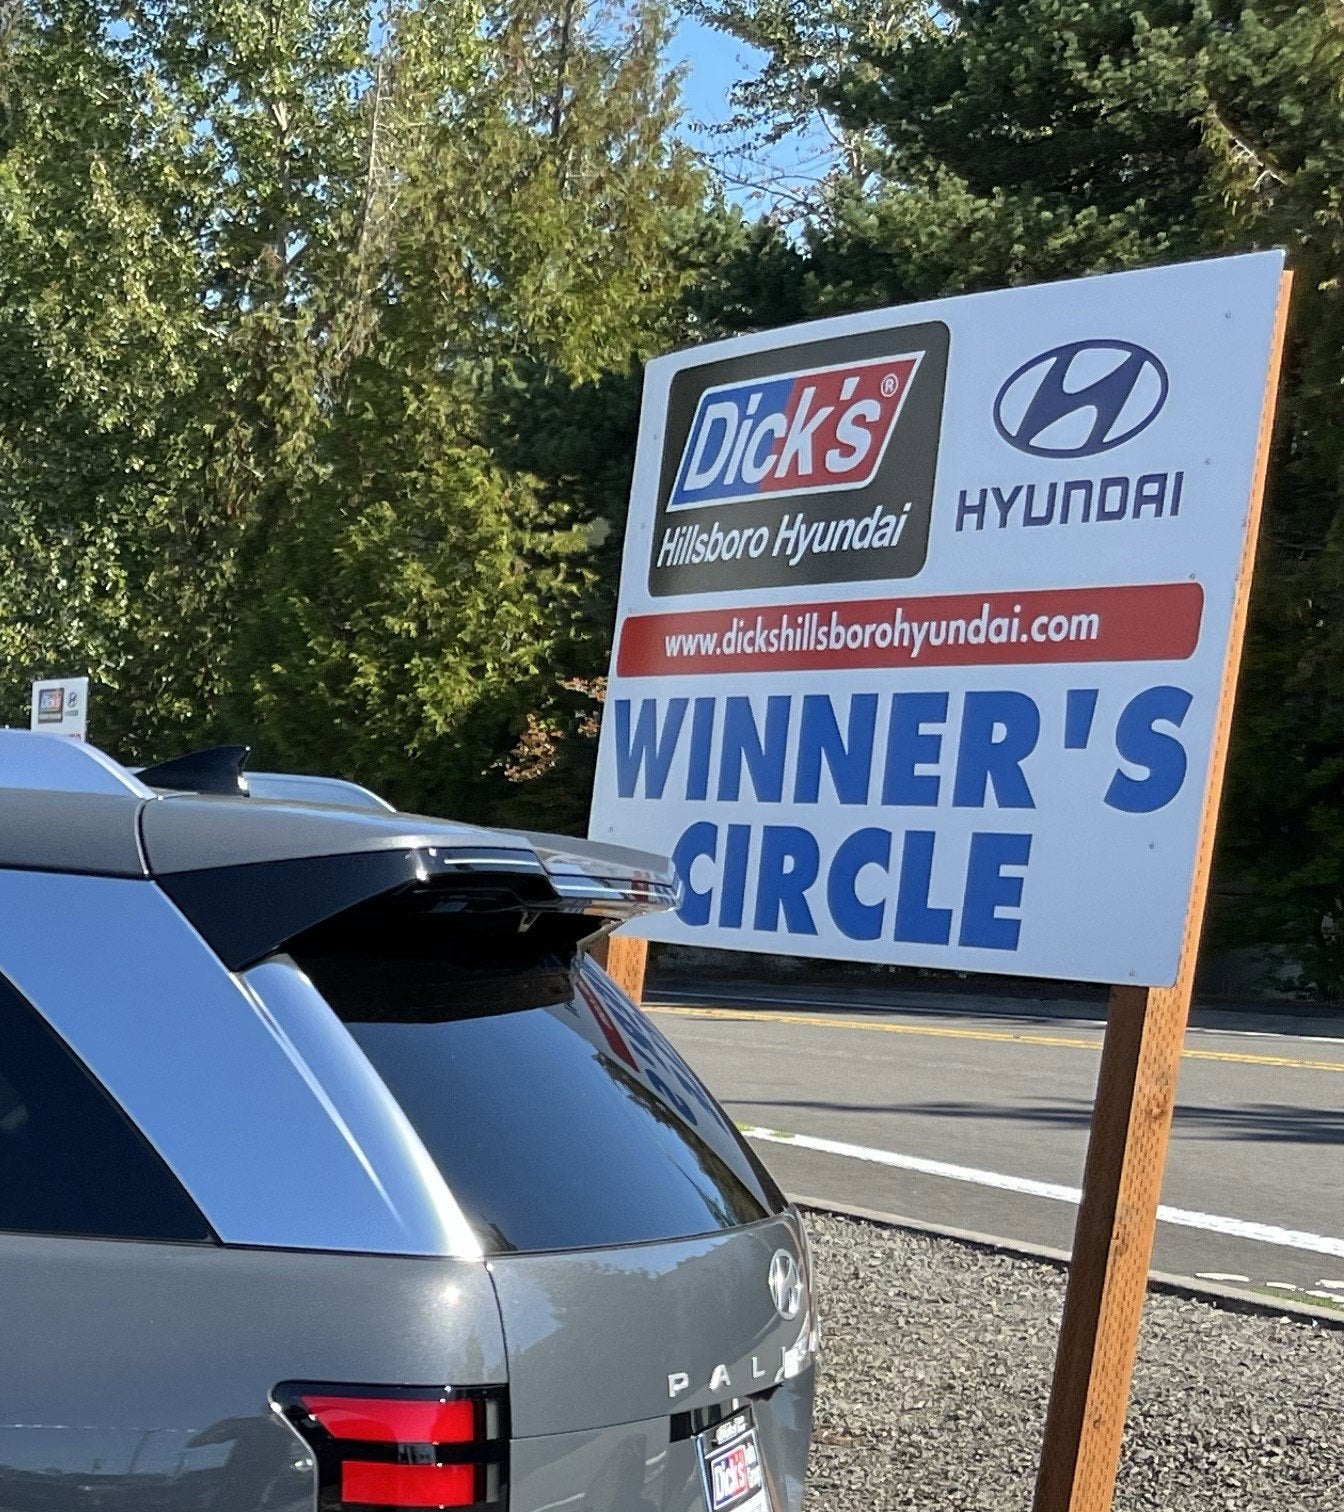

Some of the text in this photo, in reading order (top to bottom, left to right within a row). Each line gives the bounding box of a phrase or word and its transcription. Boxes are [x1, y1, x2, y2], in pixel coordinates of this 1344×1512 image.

[683, 378, 883, 493] Dick's
[657, 503, 912, 569] Hillsboro Hyundai
[956, 472, 1183, 532] HYUNDAI
[665, 604, 1100, 659] www.dickshillsborohyundai.com
[615, 685, 1194, 815] WINNER'S
[671, 820, 1033, 951] CIRCLE
